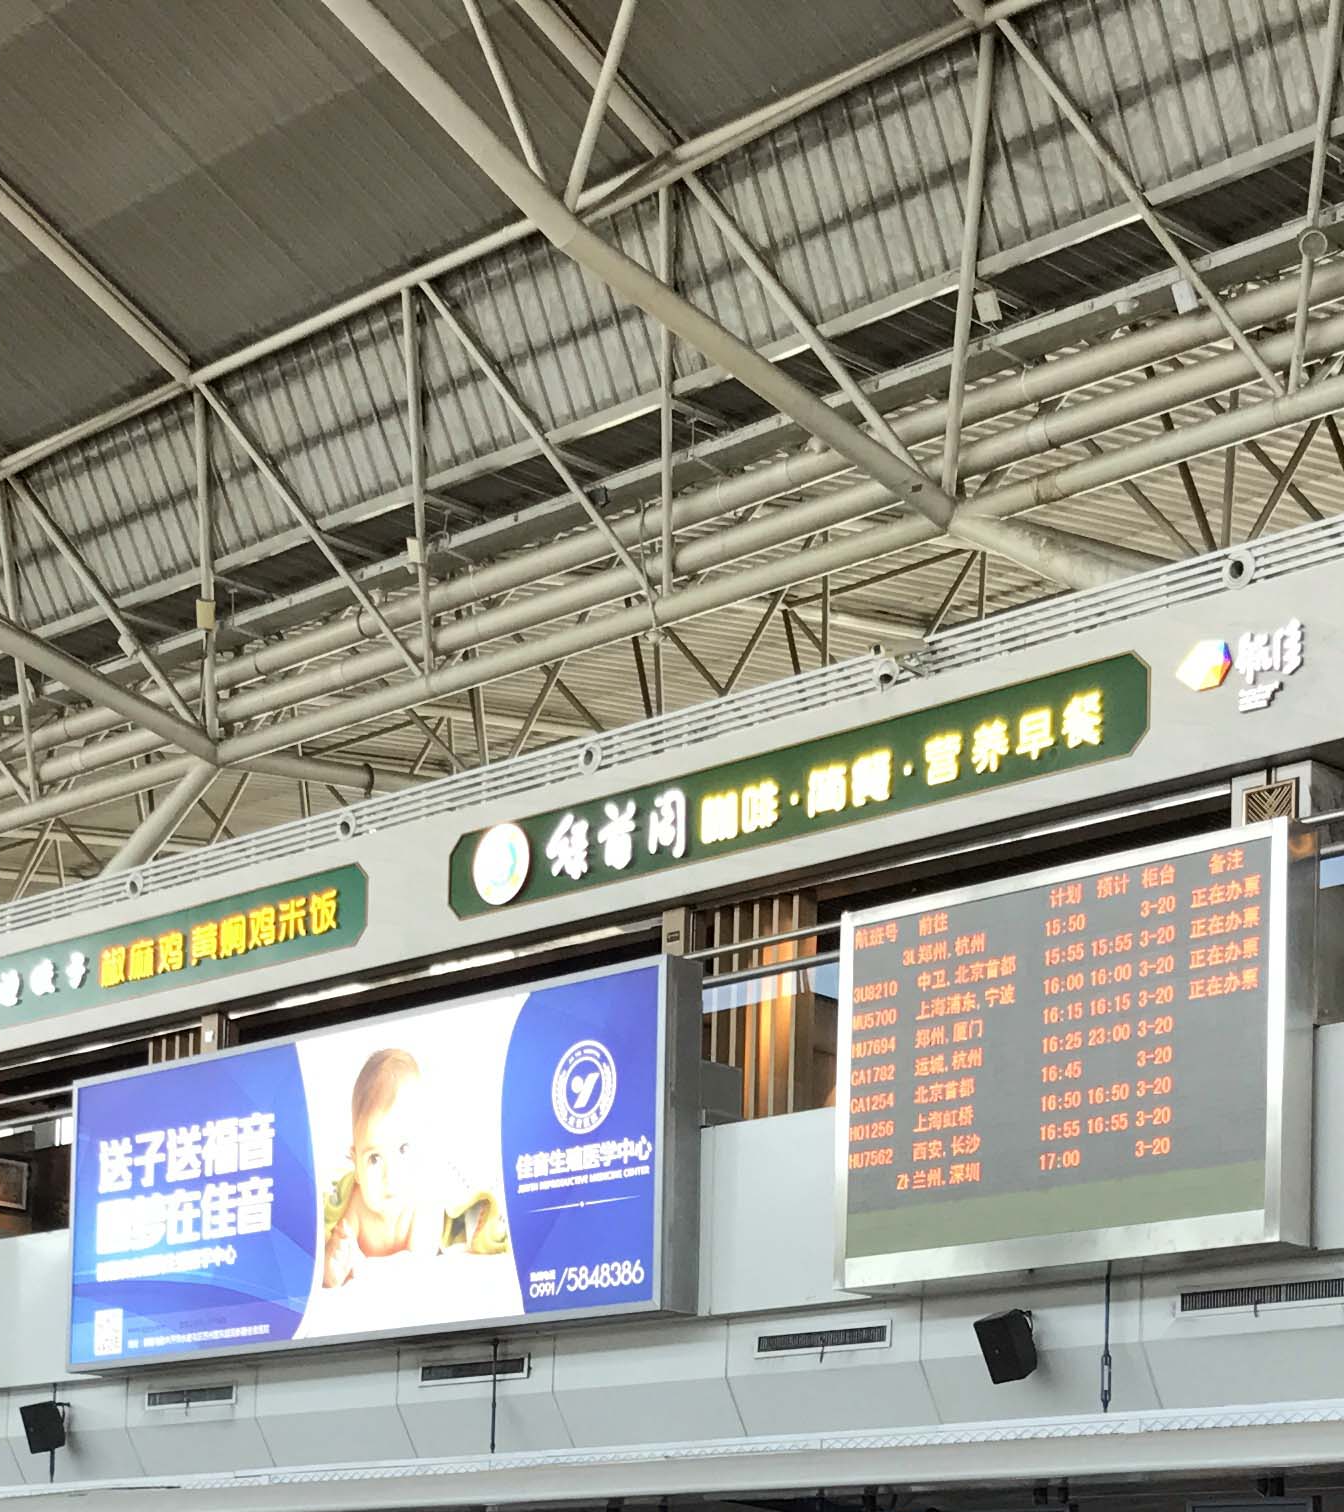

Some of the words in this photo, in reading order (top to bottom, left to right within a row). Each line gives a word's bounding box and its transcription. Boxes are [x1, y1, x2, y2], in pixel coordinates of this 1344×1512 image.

[855, 922, 898, 949] 航班号
[919, 912, 949, 936] 前往
[1049, 883, 1083, 908] 计划
[1097, 873, 1130, 898] 预计
[1141, 863, 1175, 888] 柜台
[1209, 848, 1244, 875] 备注
[1045, 913, 1086, 936] 15:50
[1140, 895, 1176, 918] 3-20
[1190, 874, 1261, 908] 正在办票
[100, 931, 185, 988] 椒麻鸡
[190, 888, 338, 967] 黄焖鸡米饭
[1043, 973, 1084, 995] 16:00
[1090, 964, 1132, 986] 16:00
[1139, 955, 1174, 977] 3-20
[1189, 936, 1260, 969] 正在办票
[1044, 943, 1085, 966] 15:55
[1091, 933, 1133, 957] 15:55
[1139, 926, 1176, 948] 3-20
[1189, 906, 1260, 939] 正在办票
[1043, 1002, 1083, 1024] 16:15
[1089, 993, 1131, 1017] 16:15
[1138, 985, 1174, 1007] 3-20
[1188, 967, 1258, 1000] 正在办票
[1042, 1032, 1083, 1054] 16:25
[1088, 1023, 1131, 1046] 23:00
[1137, 1016, 1173, 1037] 3-20
[851, 1092, 895, 1114] CA1254
[914, 1077, 975, 1104] 北京首都
[1041, 1061, 1082, 1083] 16:45
[1136, 1046, 1172, 1068] 3-20
[912, 1105, 974, 1133] 上海虹桥
[1041, 1091, 1082, 1112] 16:50
[1088, 1083, 1129, 1104] 16:50
[1136, 1076, 1172, 1097] 3-20
[98, 1112, 275, 1194] 送子送福音
[849, 1149, 893, 1170] HU7562
[1040, 1120, 1080, 1141] 16:55
[1087, 1113, 1128, 1134] 16:55
[1136, 1106, 1171, 1127] 3-20
[1039, 1150, 1080, 1171] 17:00
[1135, 1137, 1171, 1157] 3-20
